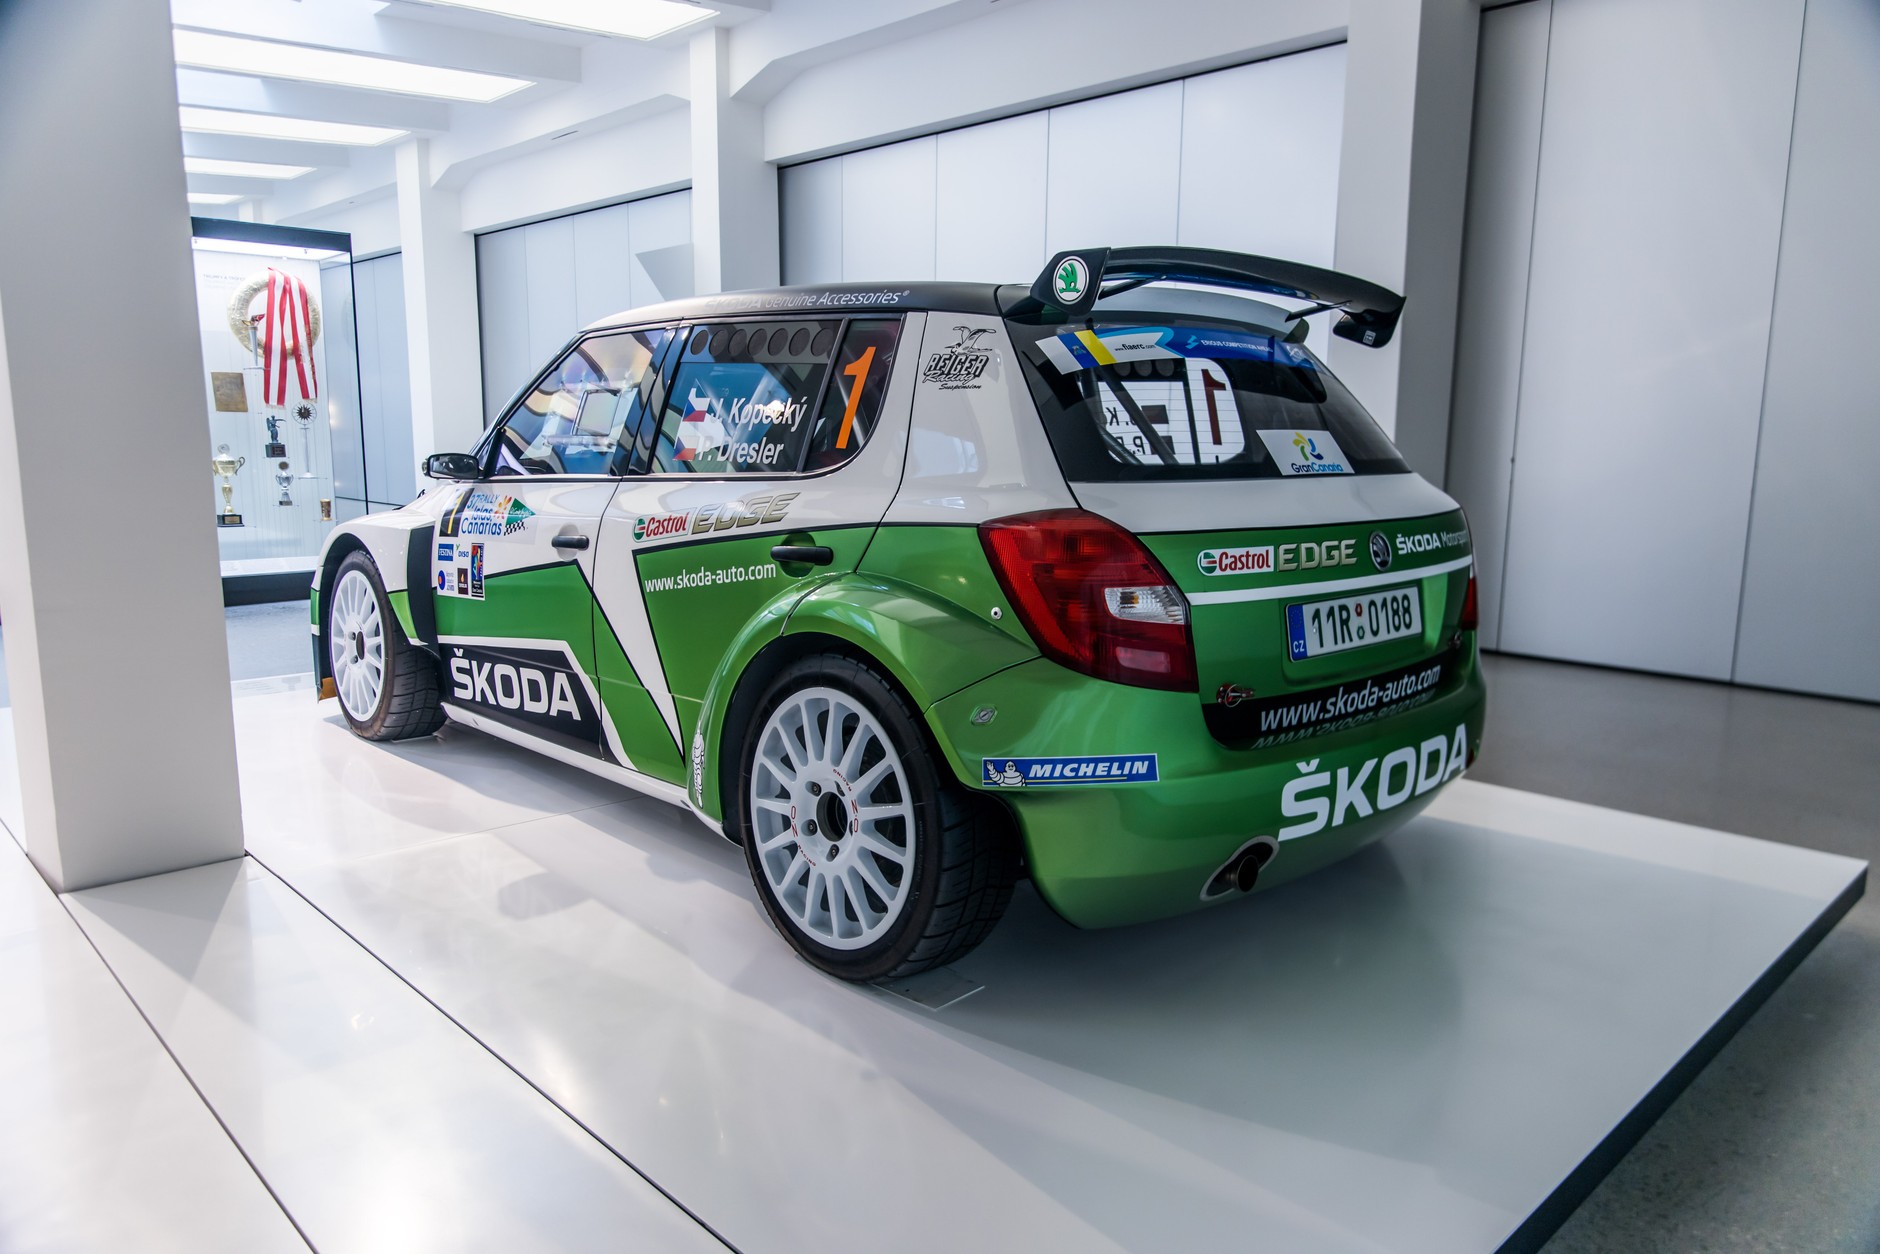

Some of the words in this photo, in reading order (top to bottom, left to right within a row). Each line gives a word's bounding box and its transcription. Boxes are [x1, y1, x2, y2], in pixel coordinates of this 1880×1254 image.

[765, 292, 817, 308] Genuine
[922, 370, 977, 385] Racing
[923, 353, 989, 378] REIGER
[835, 346, 877, 449] 1
[938, 383, 982, 391] Suspension
[727, 396, 808, 433] Kopecký
[716, 436, 785, 466] Dresler
[478, 493, 500, 506] RALLY
[461, 518, 503, 537] Canarias
[645, 511, 689, 538] Castrol
[691, 492, 801, 535] EDGE
[1218, 549, 1272, 572] Castrol
[1277, 539, 1358, 572] EDGE
[1396, 533, 1441, 555] ŠKODA
[645, 563, 776, 593] www.skoda-auto.com
[1312, 607, 1354, 649] 11R
[1368, 593, 1413, 638] 0188
[1293, 640, 1305, 653] CZ
[450, 648, 582, 722] ŠKODA
[1260, 664, 1441, 732] www.skoda-auto.com
[1029, 760, 1149, 778] MICHELIN
[1277, 723, 1469, 842] ŠKODA
